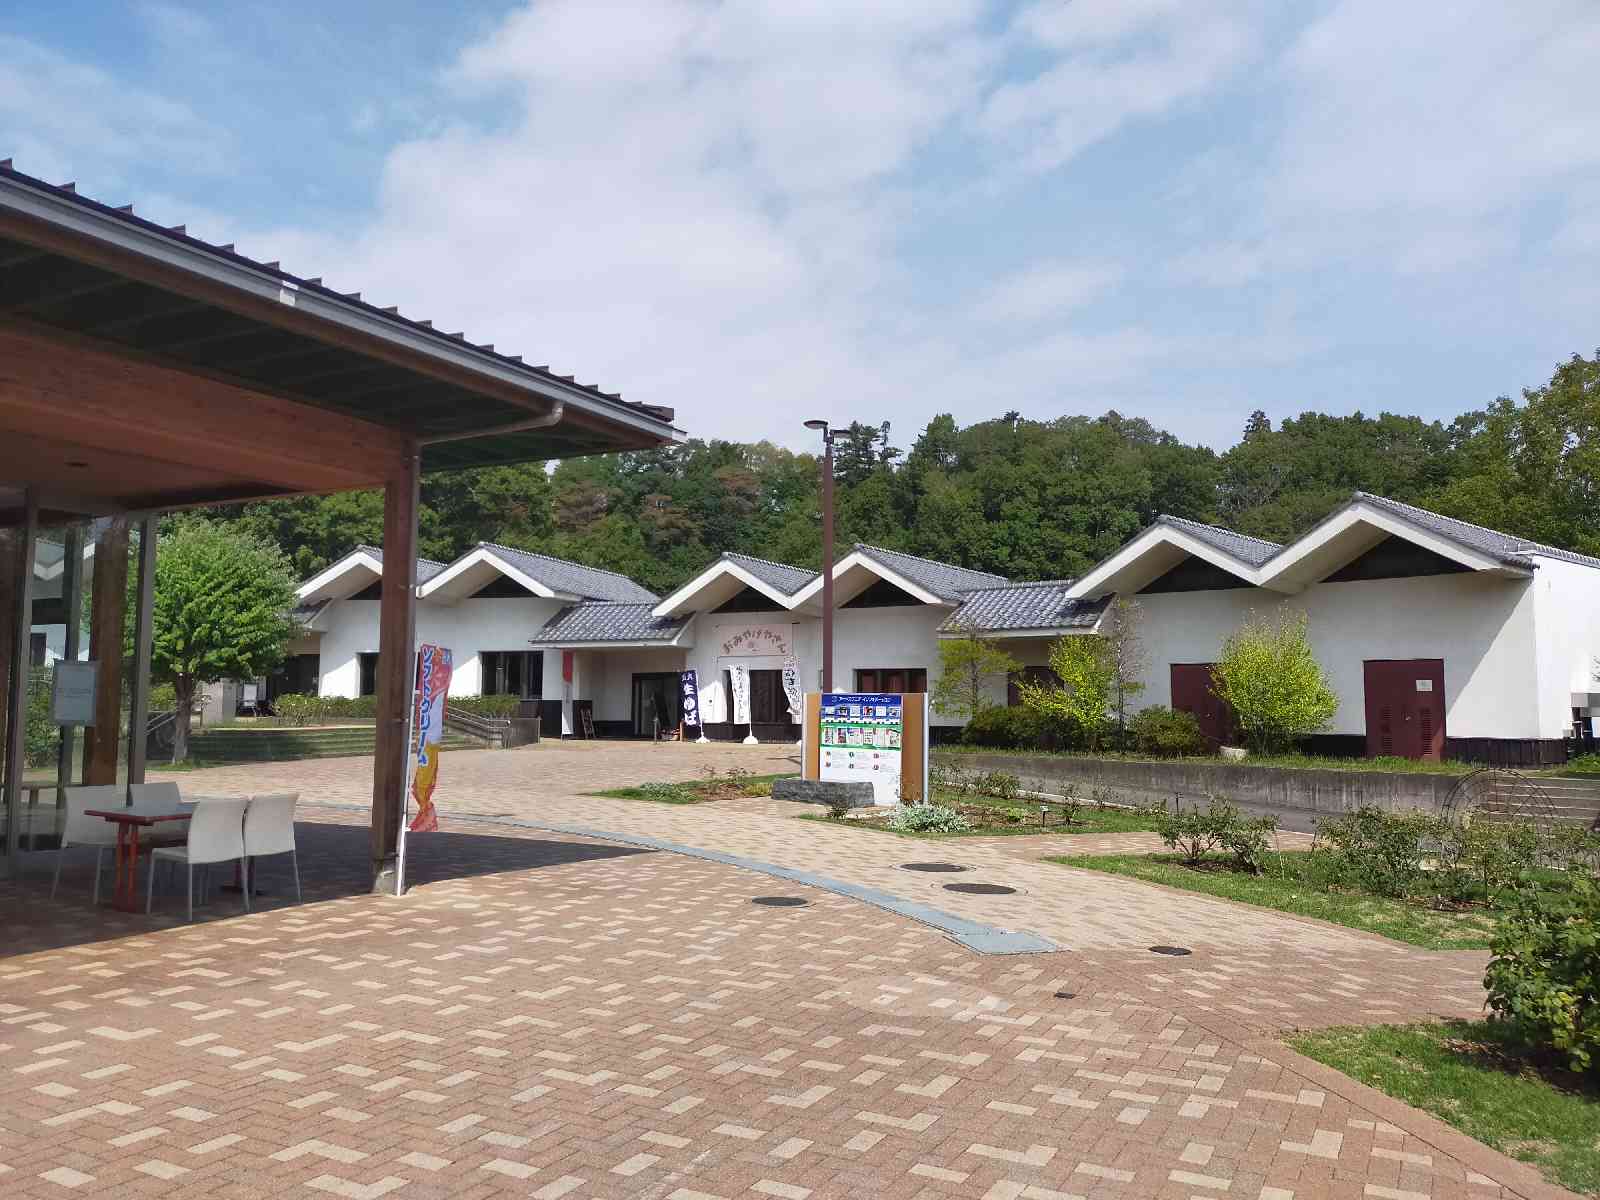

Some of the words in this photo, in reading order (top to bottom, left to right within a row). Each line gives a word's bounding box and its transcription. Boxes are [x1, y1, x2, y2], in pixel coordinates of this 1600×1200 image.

[417, 646, 434, 767] ソフトクリーム
